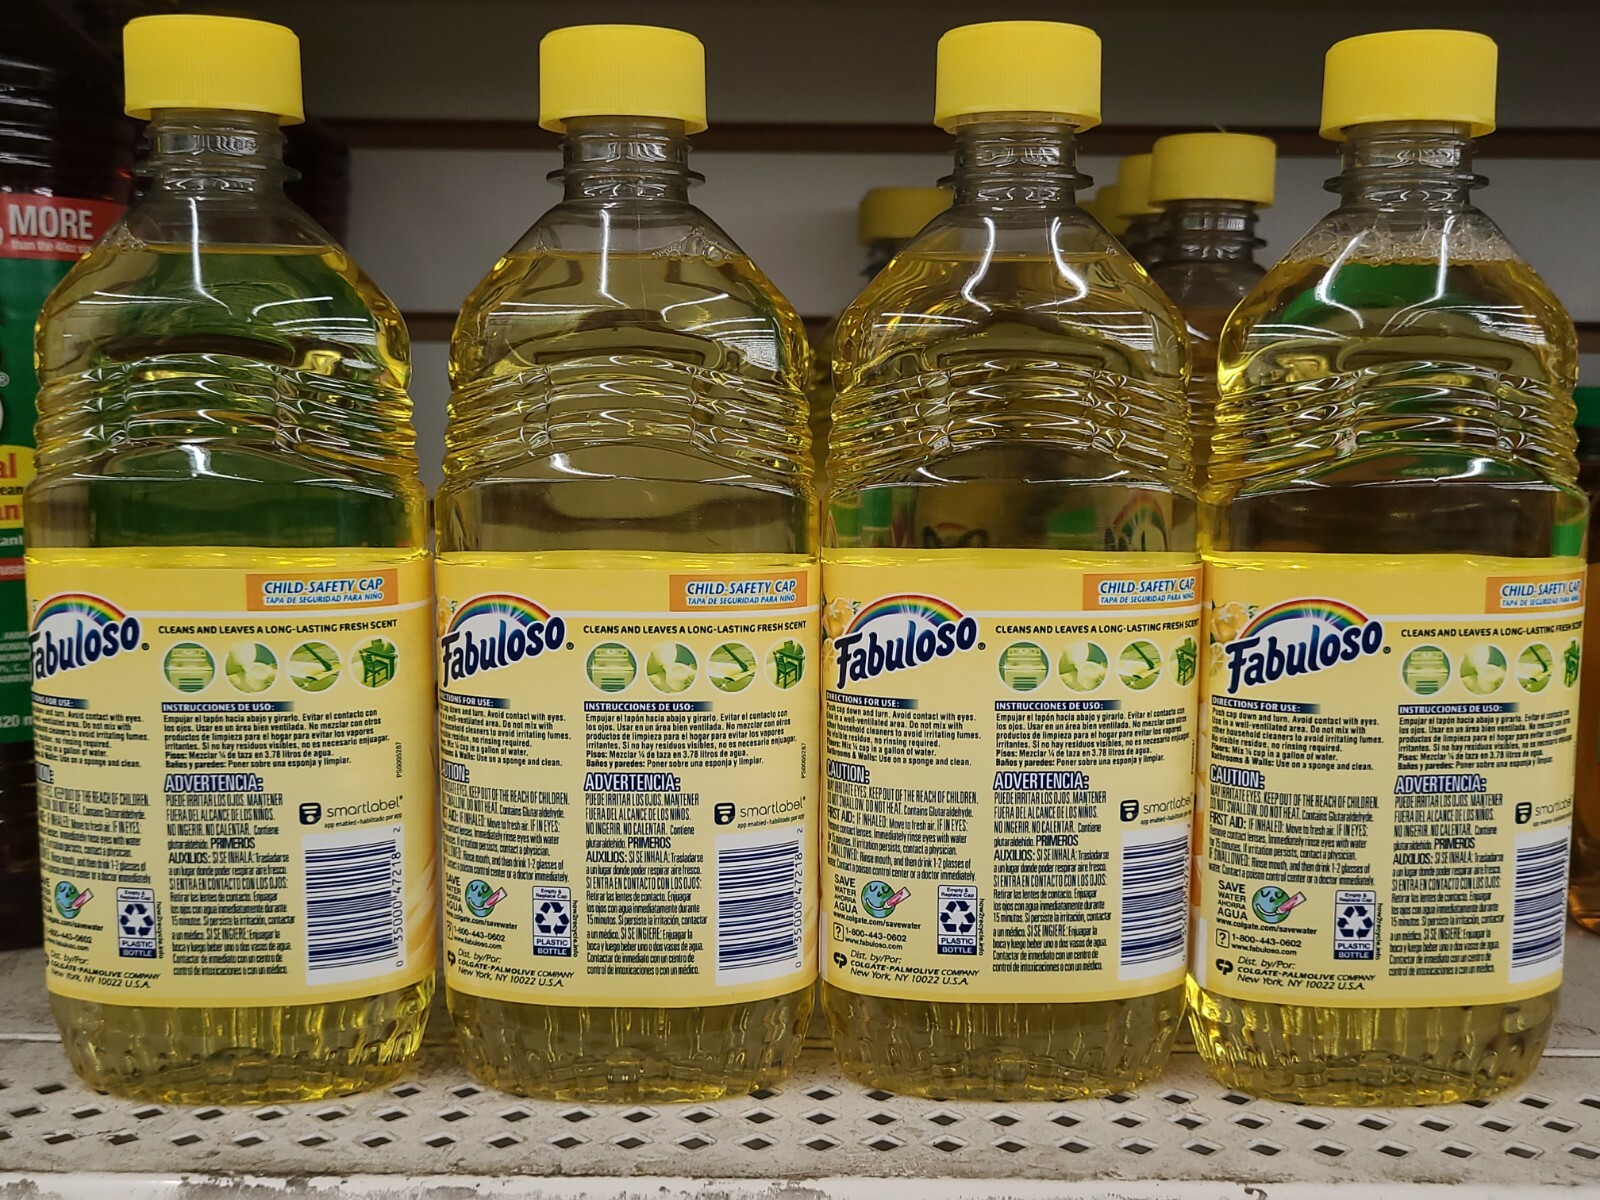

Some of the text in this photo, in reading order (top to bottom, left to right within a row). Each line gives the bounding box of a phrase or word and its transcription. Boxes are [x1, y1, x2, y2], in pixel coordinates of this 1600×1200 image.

[8, 203, 94, 240] MORE
[264, 577, 383, 594] CHILD-SAFETY CAP
[686, 580, 796, 595] CHILD-SAFETY CAP
[1099, 578, 1195, 594] CHILD-SAFETY CAP
[1501, 582, 1567, 597] CHILD-SAFETY
[265, 591, 383, 604] TAPA DE SEGURIDAD PARA NIÑO
[687, 593, 795, 605] TAPA DE SEGURIDAD PARA NIÑO
[1100, 596, 1118, 604] TAPA
[1119, 596, 1128, 604] DE
[1131, 595, 1166, 603] SEGURIDAD
[1167, 593, 1181, 602] PARA
[158, 619, 398, 634] CLEANS AND LEAVES A LONG-LASTING FRESH SCENT
[583, 619, 807, 634] CLEANS AND LEAVES A LONG-LASTING FRESH SCENT
[995, 625, 1032, 634] CLEANS
[1033, 625, 1053, 634] AND
[1055, 625, 1089, 634] LEAVES
[1090, 625, 1098, 634] A
[1099, 622, 1161, 633] LONG-LASTING
[1162, 620, 1184, 631] FRESH
[1401, 629, 1436, 638] CLEANS
[1437, 628, 1457, 637] AND
[1458, 627, 1491, 637] LEAVES
[1492, 627, 1499, 636] A
[1500, 625, 1555, 636] LONG-LASTING
[441, 617, 565, 688] Fabuloso
[834, 617, 977, 690] Fabuloso
[1225, 621, 1383, 694] Fabuloso
[827, 691, 900, 708] DIRECTIONS FOR USE:
[996, 702, 1104, 711] INSTRUCCIONES DE USO:
[1212, 696, 1301, 713] DIRECTIONS FOR USE:
[163, 703, 275, 712] INSTRUCCIONES DE USO:
[585, 702, 694, 712] INSTRUCCIONES DE USO:
[1400, 703, 1503, 714] INSTRUCCIONES DE USO:
[585, 713, 719, 724] Empujar el tapón hacia abajo y girarlo.
[1226, 710, 1238, 720] cap
[1238, 711, 1257, 721] down
[1258, 712, 1272, 722] and
[1273, 713, 1290, 723] turn.
[1292, 714, 1313, 724] Avoid
[1314, 716, 1342, 726] contact
[1342, 716, 1359, 726] with
[1360, 717, 1380, 727] eyes.
[826, 759, 870, 784] CAUTION:
[1209, 764, 1265, 790] CAUTION:
[164, 773, 264, 793] ADVERTENCIA:
[584, 772, 681, 792] ADVERTENCIA:
[992, 771, 1090, 791] ADVERTENCIA:
[1394, 774, 1487, 794] ADVERTENCIA:
[391, 852, 402, 894] 47218
[794, 852, 803, 895] 47218
[834, 874, 856, 888] SAVE
[1218, 879, 1246, 894] SAVE
[834, 885, 857, 897] WATER
[1217, 890, 1246, 903] WATER
[834, 894, 857, 904] AHORRA
[1217, 899, 1246, 911] AHORRA
[834, 902, 858, 915] AGUA
[1217, 907, 1248, 921] AGUA
[392, 900, 404, 945] 35000
[793, 901, 803, 944] 35000
[833, 911, 921, 930] www.colgate.com/savewater
[1216, 917, 1317, 935] www.colgate.com/savewater
[845, 928, 907, 942] 1-800-443-0602
[940, 937, 974, 945] PLASTIC
[1231, 933, 1302, 948] 1-800-443-0602
[122, 940, 153, 948] PLASTIC
[536, 938, 568, 947] PLASTIC
[845, 936, 903, 950] www.fabuloso.com
[1231, 943, 1297, 956] www.fabuloso.com
[1337, 942, 1371, 950] PLASTIC
[123, 949, 153, 957] BOTTLE
[537, 947, 567, 956] BOTTLE
[850, 950, 902, 964] Dist. by/Por:
[942, 946, 973, 954] BOTTLE
[1338, 951, 1370, 959] BOTTLE
[794, 960, 802, 968] 0
[850, 960, 979, 977] COLGATE-PALMOLIVE COMPANY
[1238, 956, 1296, 970] Dist. by/Por:
[850, 968, 868, 978] New
[871, 970, 891, 981] York,
[894, 973, 908, 982] NY
[911, 974, 939, 984] 10022
[1237, 966, 1377, 982] COLGATE-PALMOLIVE COMPANY
[1237, 974, 1260, 984] New
[1287, 979, 1303, 988] NY
[1305, 980, 1335, 990] 10022
